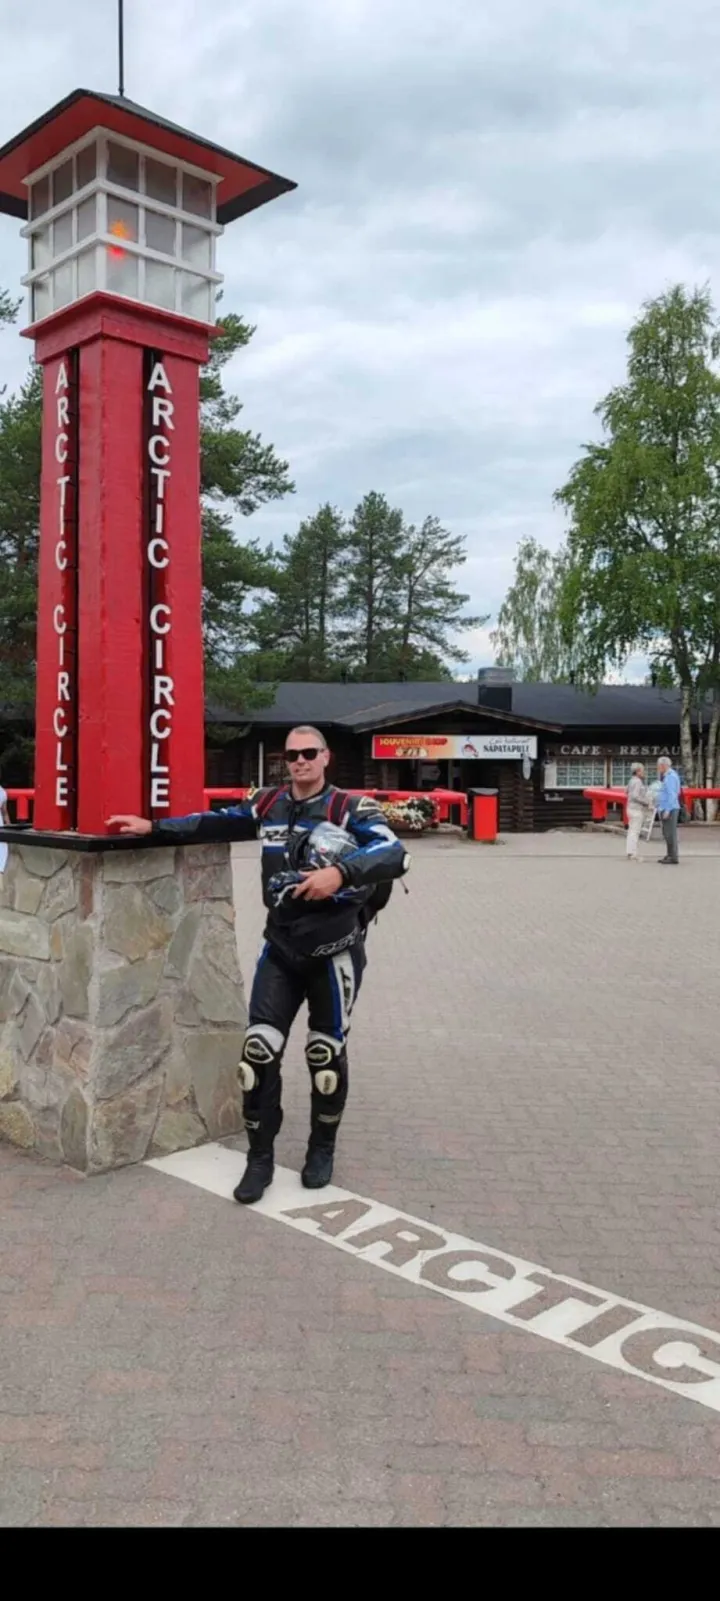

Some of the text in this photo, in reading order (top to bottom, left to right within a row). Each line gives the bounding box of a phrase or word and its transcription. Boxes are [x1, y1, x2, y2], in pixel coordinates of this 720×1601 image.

[53, 362, 71, 808] ARCTIC CIRCLE
[147, 362, 175, 808] ARCTIC CIRCLE
[560, 745, 601, 755] CAFE
[281, 1198, 720, 1385] ARCTIC
